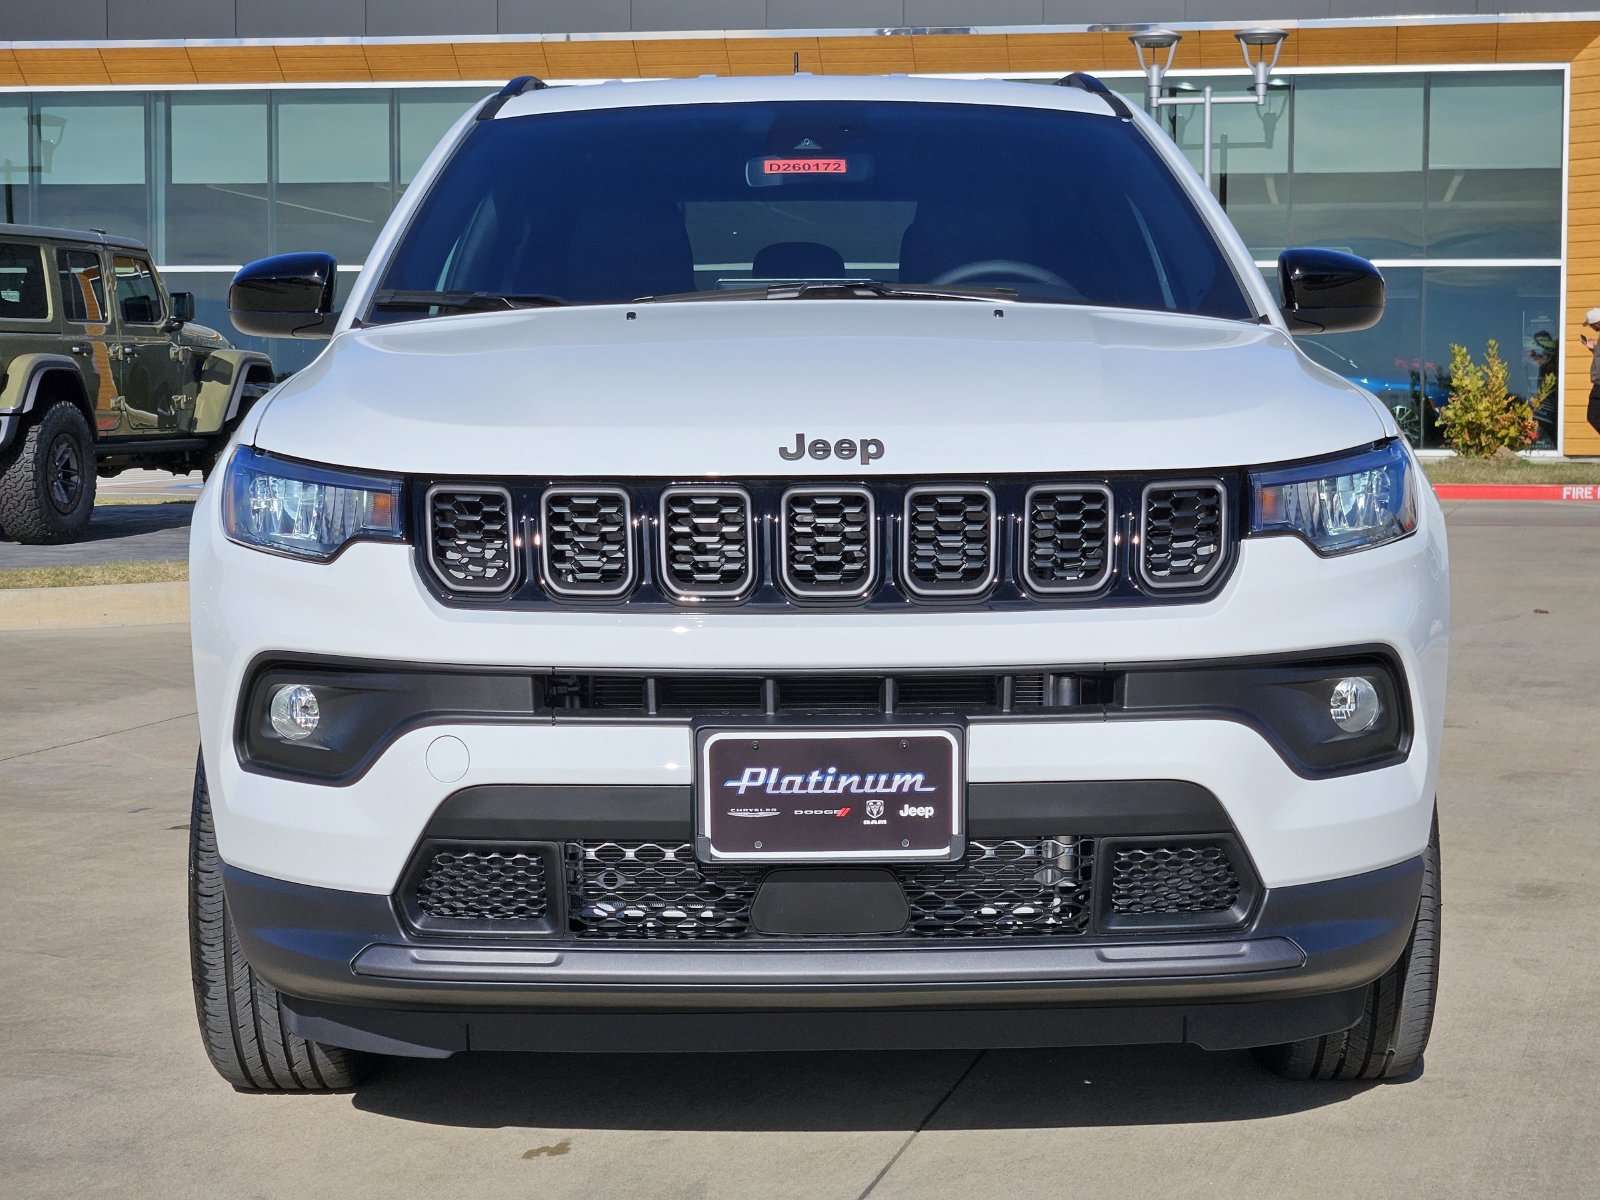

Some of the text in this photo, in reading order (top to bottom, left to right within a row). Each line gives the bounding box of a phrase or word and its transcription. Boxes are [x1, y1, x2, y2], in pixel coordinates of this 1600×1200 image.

[769, 162, 842, 172] D260172
[778, 433, 885, 465] Jeep
[1562, 486, 1594, 500] FIRE
[723, 766, 938, 795] Platinum
[899, 803, 935, 819] Jeep
